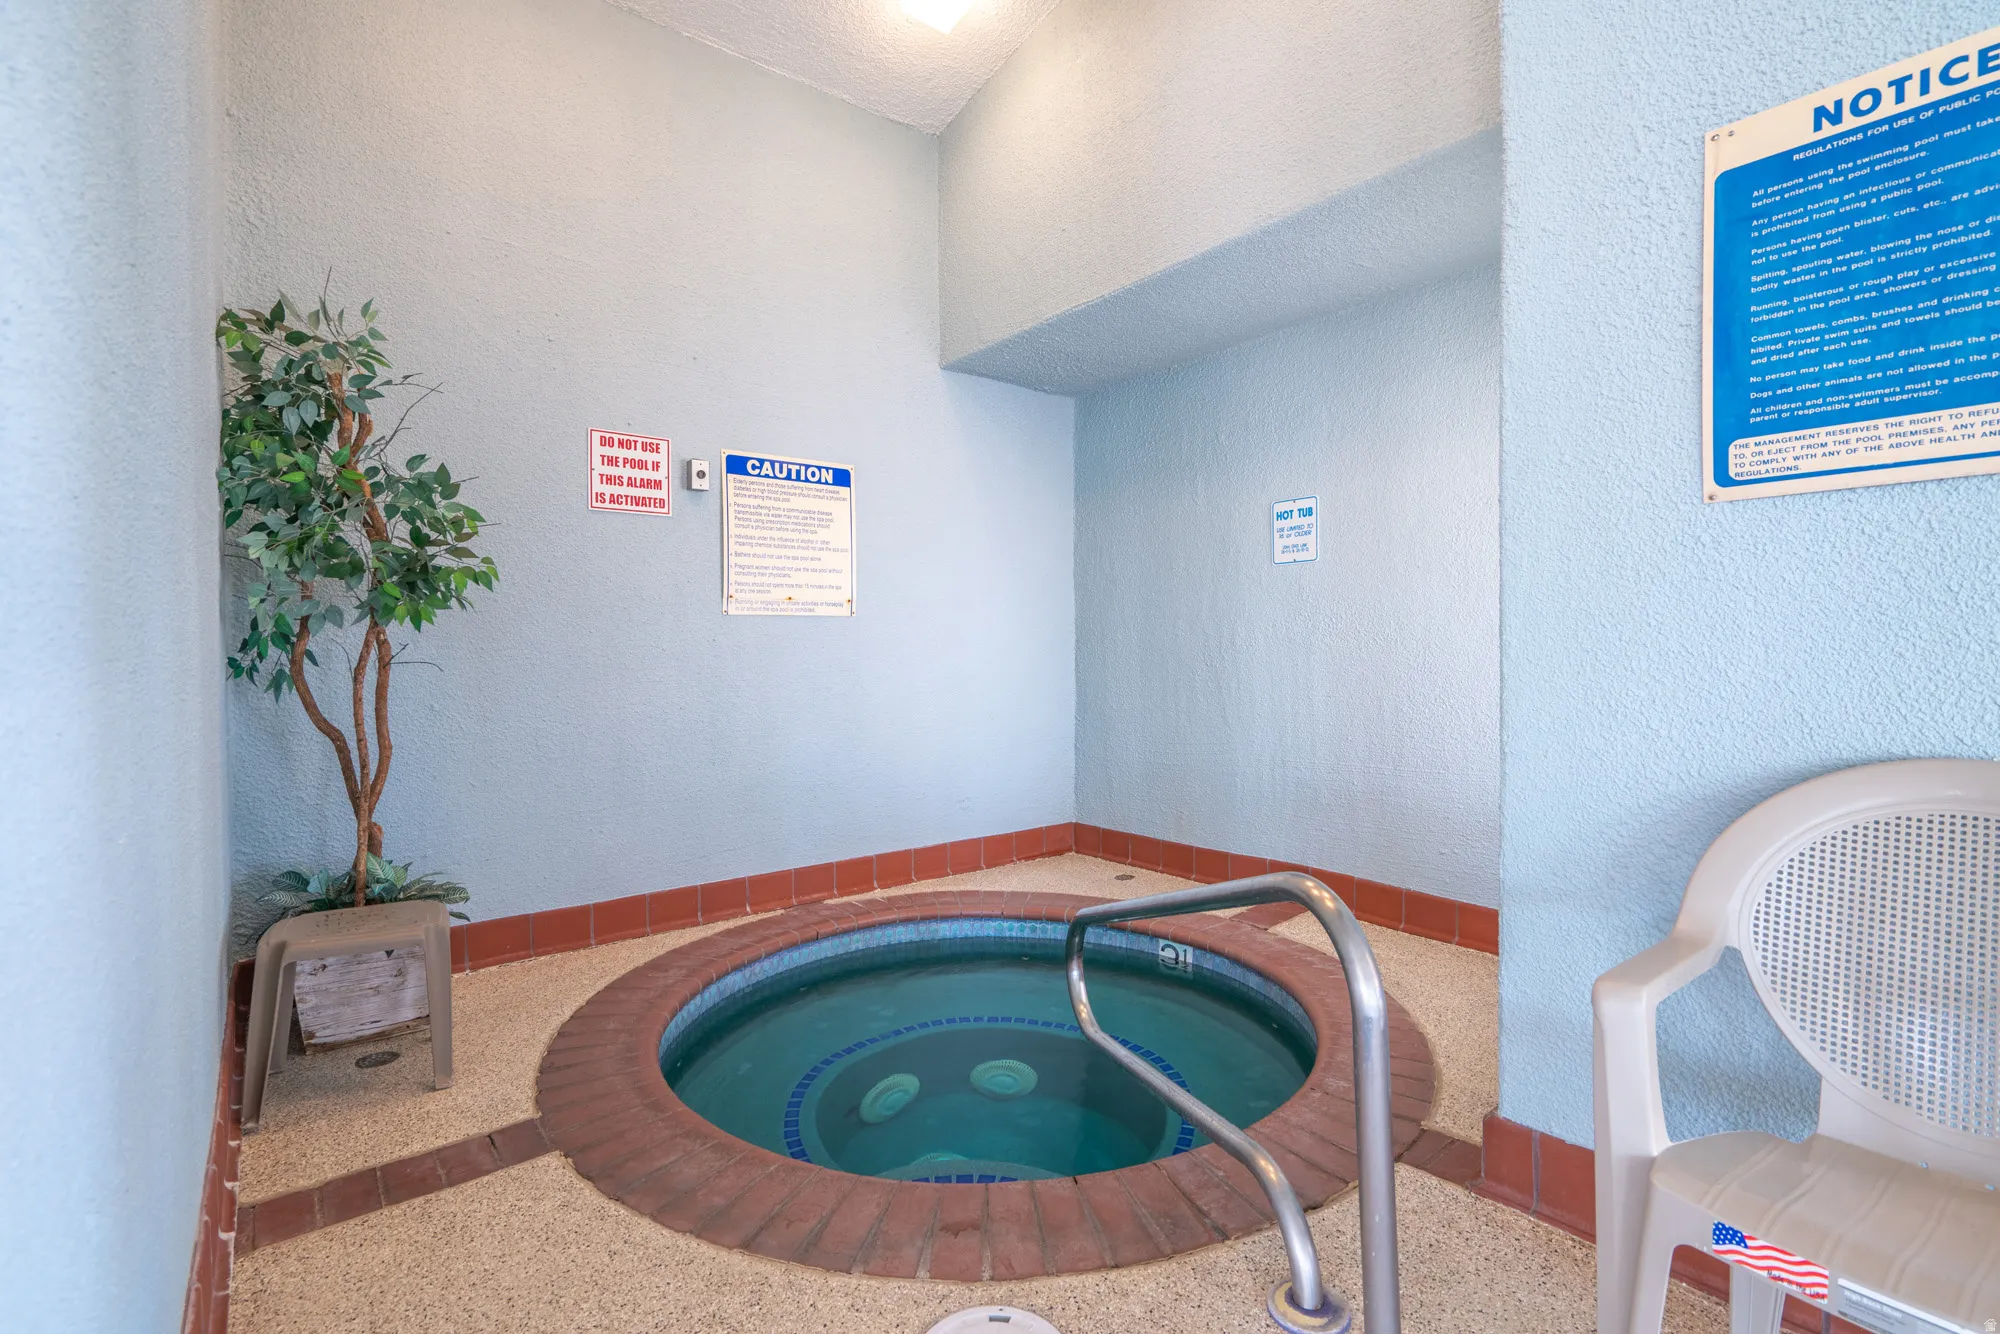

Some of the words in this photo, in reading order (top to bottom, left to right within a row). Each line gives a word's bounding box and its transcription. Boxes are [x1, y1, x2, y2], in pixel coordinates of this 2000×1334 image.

[1813, 42, 2000, 133] NOTICE
[1793, 132, 1864, 161] REGULATIONS
[1867, 124, 1889, 137] FOR
[1893, 115, 1915, 129] USE
[1919, 109, 1934, 120] OF
[1938, 94, 1981, 114] PUBLIC
[1752, 188, 1765, 198] All
[1767, 177, 1804, 194] persons
[1807, 168, 1834, 180] using
[1837, 162, 1854, 171] the
[1856, 144, 1909, 165] swimming
[1914, 134, 1939, 148] pool
[1943, 124, 1971, 138] must
[1751, 195, 1781, 208] before
[1784, 182, 1823, 199] entering
[1828, 176, 1845, 185] the
[1847, 166, 1870, 180] pool
[1751, 218, 1768, 227] Any
[1772, 207, 1804, 222] person
[1807, 197, 1840, 211] having
[1843, 192, 1855, 200] an
[1859, 176, 1911, 195] infectious
[1915, 171, 1926, 179] or
[1751, 241, 1787, 256] Persons
[1790, 232, 1822, 245] having
[1825, 224, 1850, 235] open
[1951, 192, 1969, 202] are
[1761, 216, 1809, 236] prohibited
[1812, 209, 1836, 220] from
[1839, 200, 1867, 213] using
[1880, 187, 1913, 202] public
[1750, 282, 1779, 294] bodily
[1783, 273, 1816, 286] wastes
[1831, 266, 1847, 274] the
[1851, 258, 1874, 270] pool
[1890, 246, 1928, 260] strictly
[1751, 256, 1766, 266] not
[1781, 249, 1798, 258] use
[1801, 244, 1817, 253] the
[1793, 286, 1844, 303] boisterous
[1863, 275, 1893, 287] rough
[1897, 269, 1920, 280] play
[1939, 251, 1996, 269] excessive
[1750, 356, 1768, 365] and
[1770, 351, 1795, 362] dried
[1797, 347, 1820, 357] after
[1823, 341, 1847, 352] each
[1765, 402, 1802, 413] children
[1805, 397, 1823, 406] and
[1826, 386, 1900, 403] non-swimmers
[1904, 380, 1931, 391] must
[1953, 370, 2000, 383] accomp
[1749, 413, 1778, 424] parent
[1794, 402, 1850, 416] responsible
[1854, 397, 1880, 407] adult
[600, 435, 614, 448] DO
[618, 438, 638, 451] NOT
[641, 441, 660, 454] USE
[1754, 432, 1820, 447] MANAGEMENT
[1825, 424, 1879, 437] RESERVES
[1909, 416, 1942, 425] RIGHT
[600, 454, 620, 467] THE
[623, 457, 649, 471] POOL
[652, 461, 660, 472] IF
[1749, 457, 1786, 467] COMPLY
[1792, 453, 1817, 461] WITH
[1888, 440, 1922, 449] ABOVE
[1929, 433, 1975, 444] HEALTH
[599, 473, 624, 486] THIS
[627, 476, 662, 490] ALARM
[746, 460, 833, 484] CAUTION
[596, 492, 606, 504] IS
[609, 493, 665, 509] ACTIVATED
[1276, 509, 1294, 521] HOT
[1297, 506, 1314, 518] TUB
